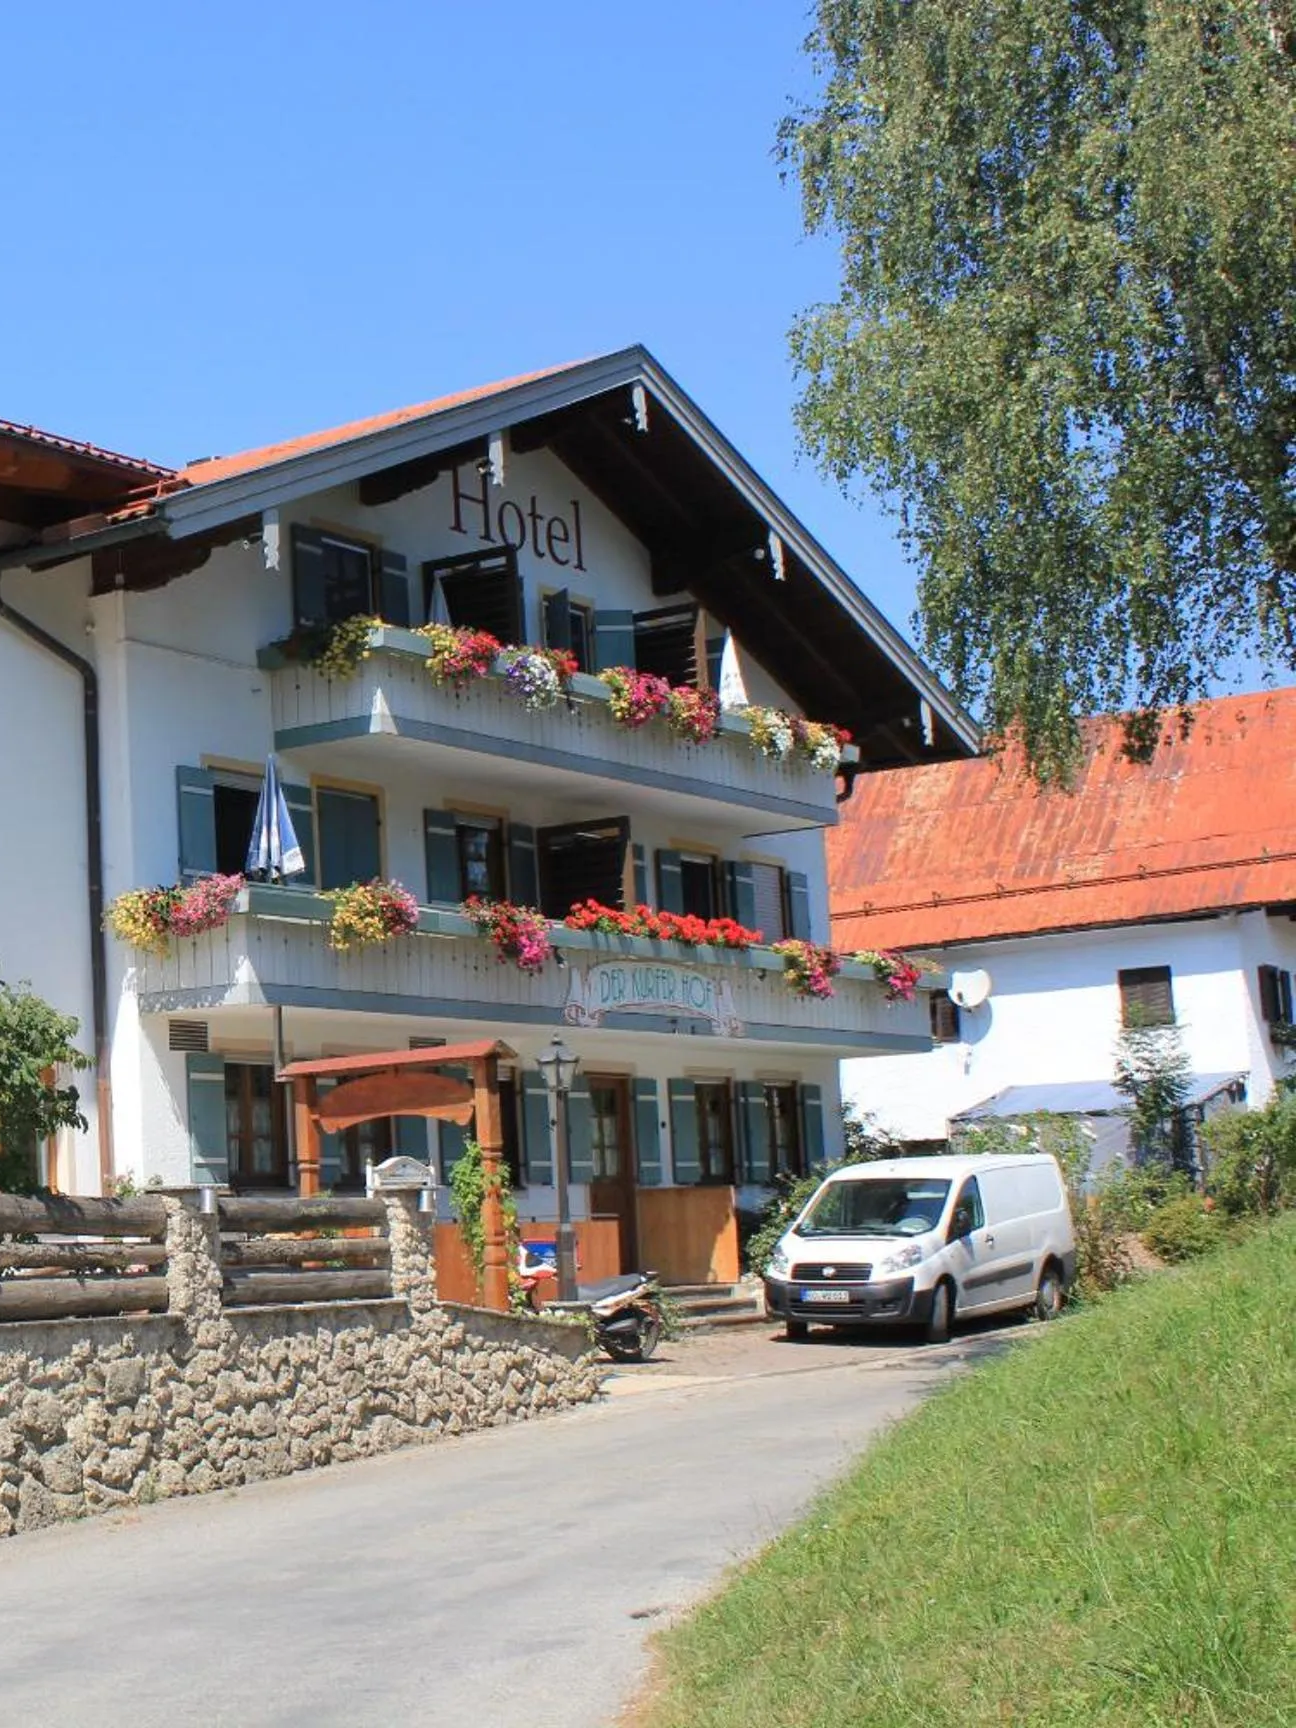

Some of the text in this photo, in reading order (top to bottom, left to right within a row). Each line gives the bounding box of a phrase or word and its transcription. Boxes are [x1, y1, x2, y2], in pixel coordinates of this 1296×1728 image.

[449, 466, 587, 573] Hotel
[599, 967, 625, 1003] DER
[681, 974, 714, 1011] HOF
